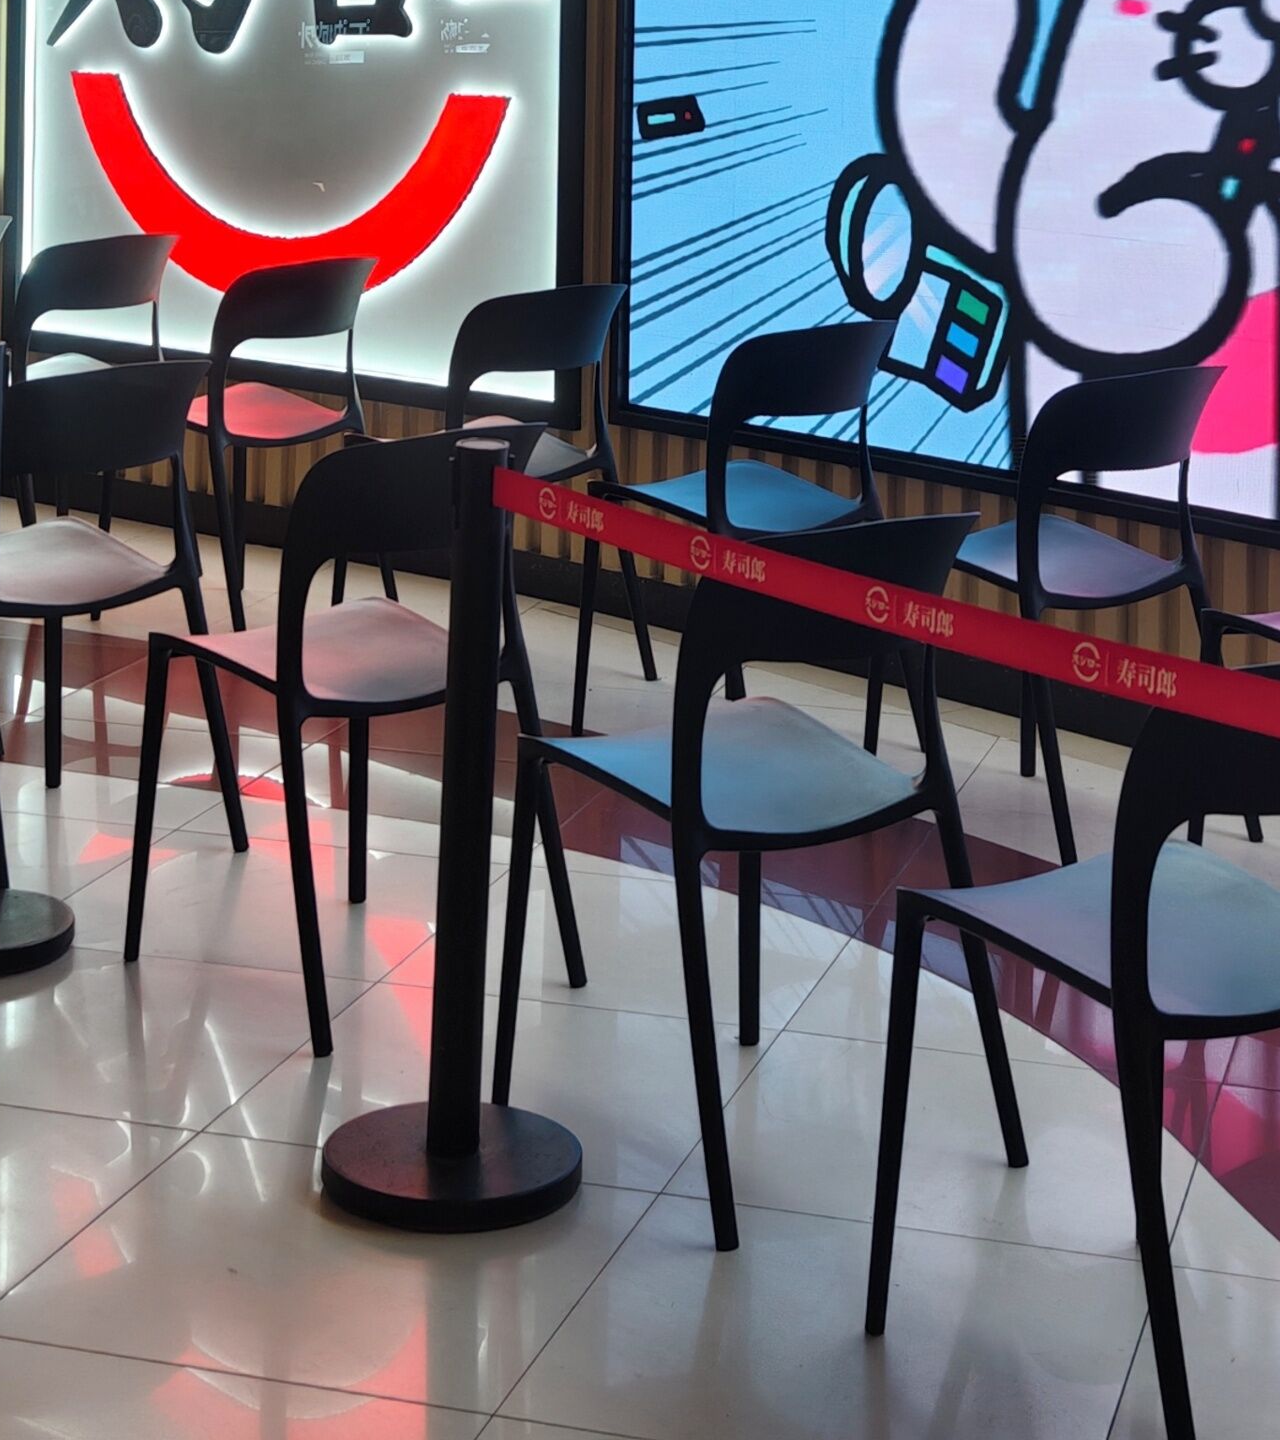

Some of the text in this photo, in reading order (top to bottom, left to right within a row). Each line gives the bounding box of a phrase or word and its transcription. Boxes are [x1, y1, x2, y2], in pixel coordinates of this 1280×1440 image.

[566, 500, 605, 534] 寿司郎
[722, 548, 767, 584] 寿司郎
[902, 601, 955, 638] 寿司郎
[1116, 657, 1178, 699] 寿司郎
